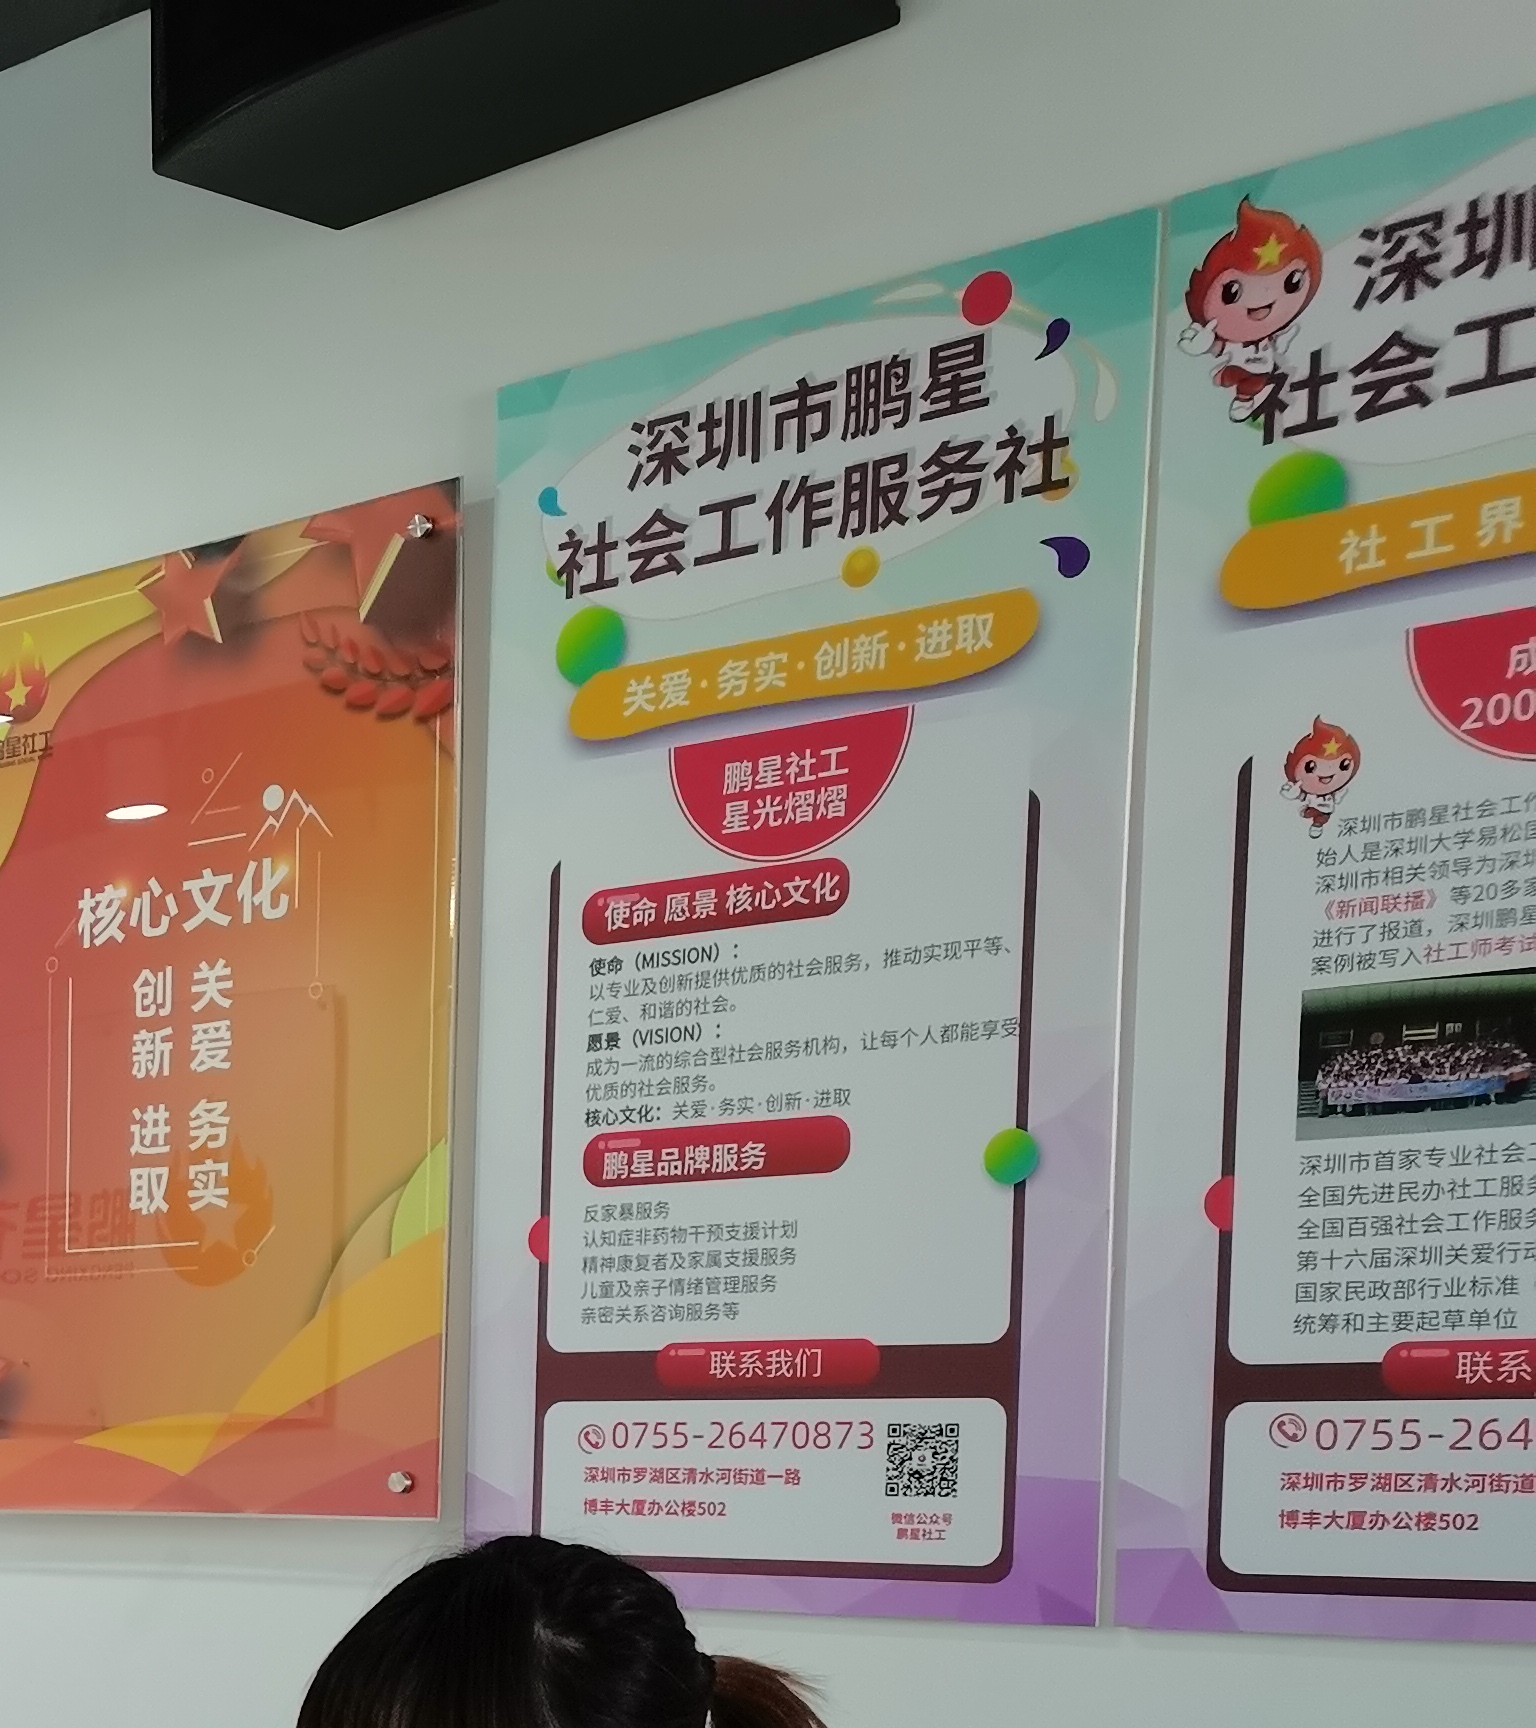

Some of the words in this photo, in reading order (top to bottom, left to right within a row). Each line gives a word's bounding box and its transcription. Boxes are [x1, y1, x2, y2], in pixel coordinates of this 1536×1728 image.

[1254, 306, 1536, 446] 社会工
[627, 333, 989, 491] 深圳市鹏星
[557, 415, 1071, 600] 社会工作服务社
[1340, 497, 1522, 575] 社工界
[623, 612, 994, 717] 关爱·务实·创新·进取
[722, 746, 849, 794] 鹏星社工
[721, 785, 848, 835] 星光熠熠
[78, 857, 289, 948] 核心文化
[605, 899, 656, 932] 使命
[664, 890, 717, 923] 愿景
[726, 872, 840, 915] 核心文化
[132, 966, 173, 1078] 创新
[191, 958, 233, 1073] 关爱
[129, 1104, 171, 1215] 进取
[189, 1099, 230, 1212] 务实
[602, 1142, 766, 1180] 鹏星品牌服务
[583, 1201, 669, 1224] 反家暴服务
[583, 1219, 798, 1248] 认知症非药物干预支援计划
[581, 1246, 796, 1275] 精神康复者及家属支援服务
[580, 1273, 777, 1300] 儿童及亲子情绪管理服务
[580, 1300, 740, 1325] 亲密关系咨询服务等
[1293, 1309, 1518, 1336] 统筹和主要起草单位
[709, 1347, 823, 1379] 联系我们
[1456, 1350, 1532, 1384] 联系
[612, 1420, 874, 1450] 0755-26470873
[1315, 1417, 1533, 1452] 0755-264
[583, 1466, 801, 1486] 深圳市罗湖区清水河街道一路
[583, 1498, 726, 1518] 博丰大厦办公楼502
[1279, 1510, 1480, 1532] 博丰大厦办公楼502
